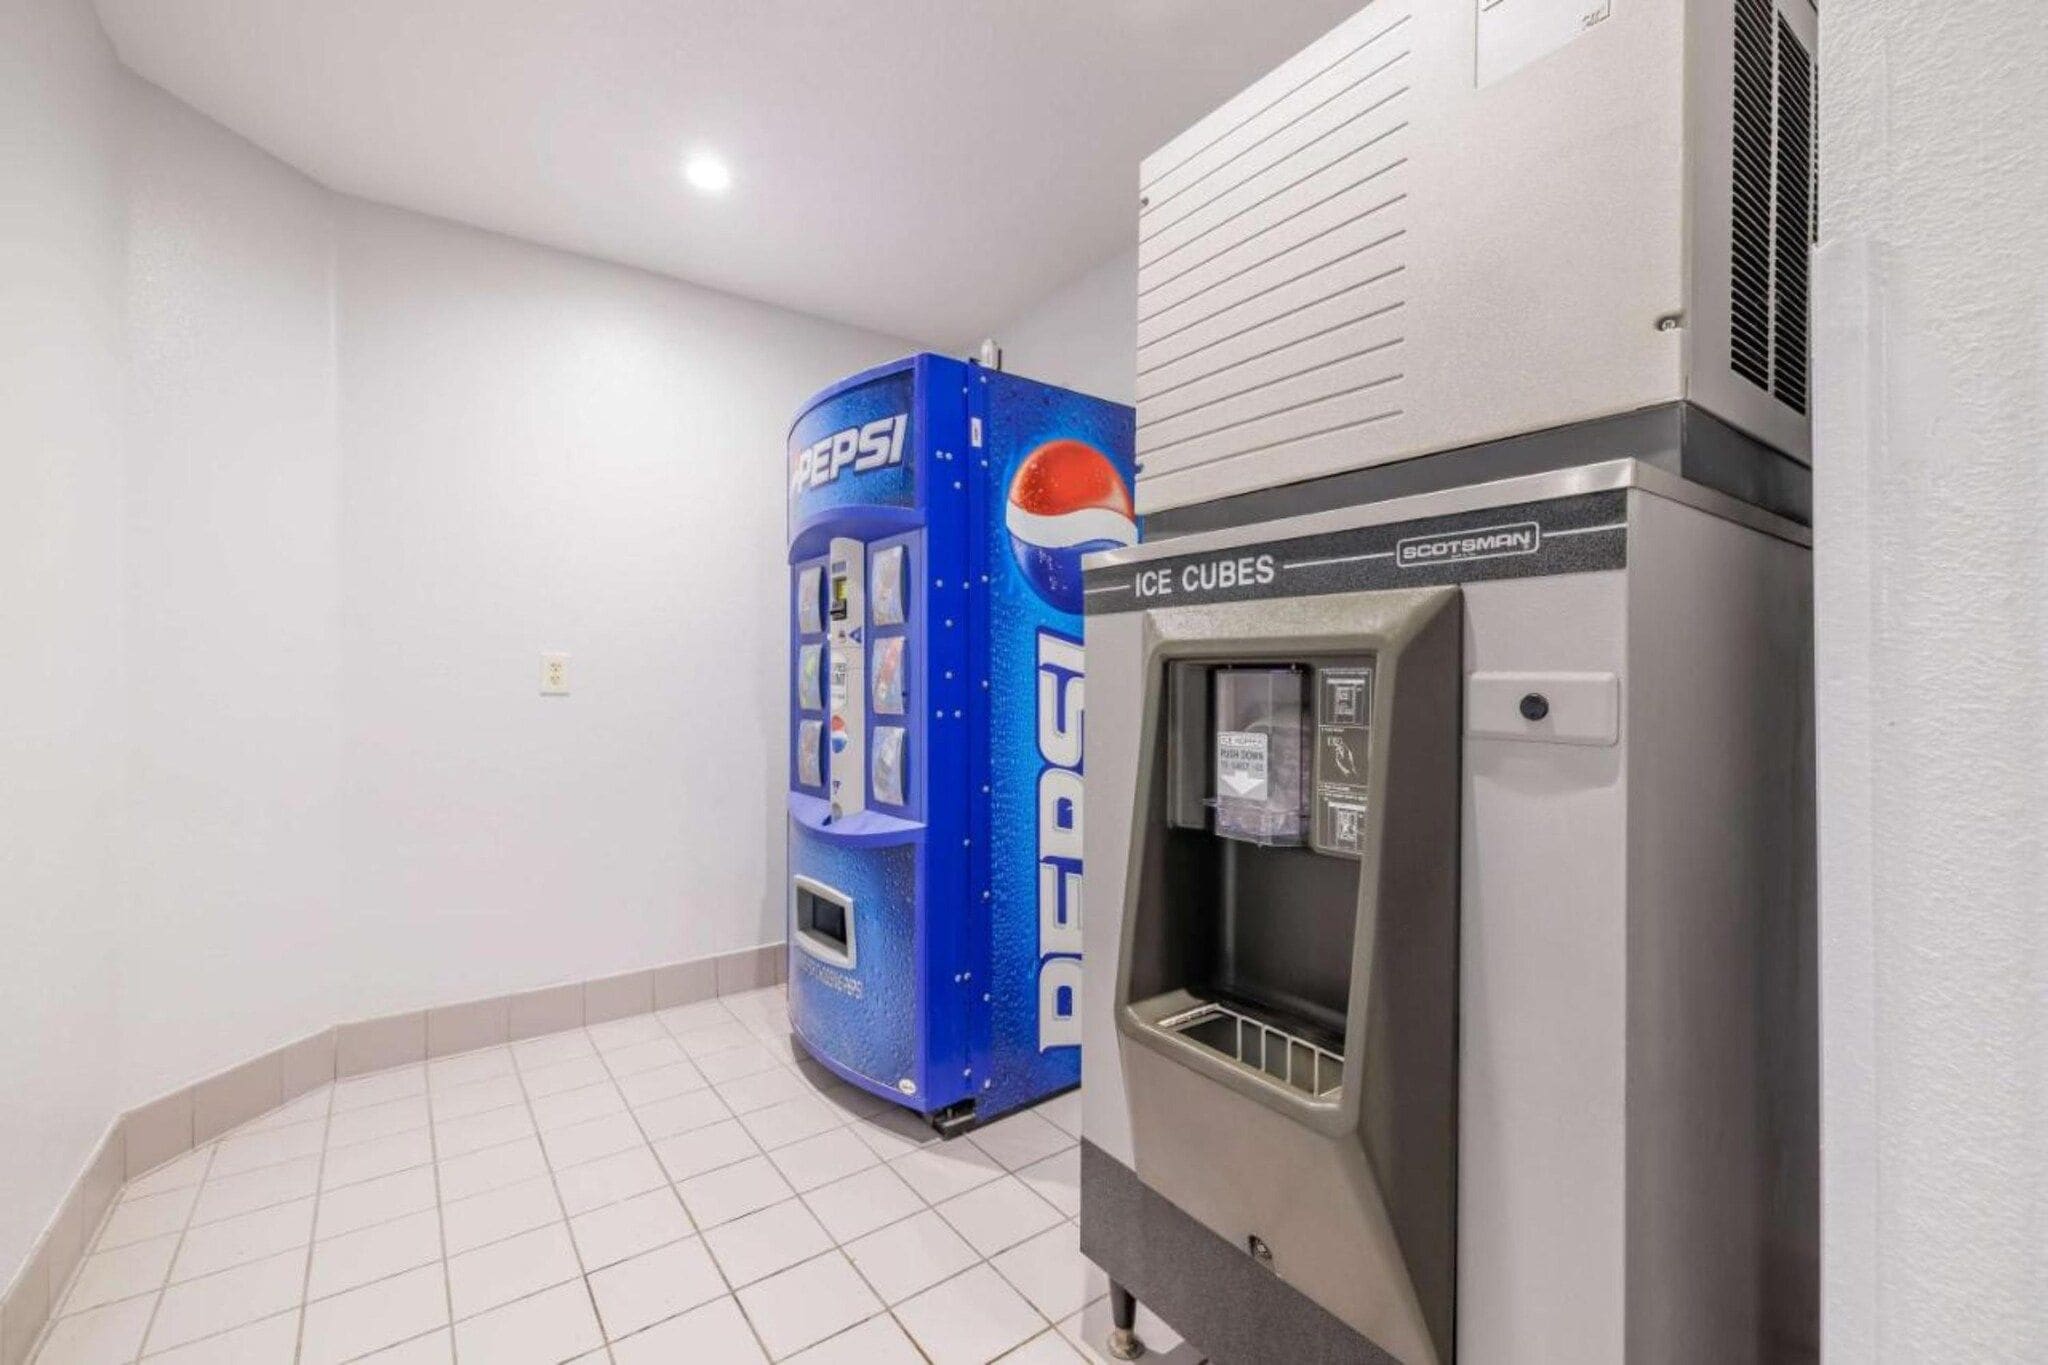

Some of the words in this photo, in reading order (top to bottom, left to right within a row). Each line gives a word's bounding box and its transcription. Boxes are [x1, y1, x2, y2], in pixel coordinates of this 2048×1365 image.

[791, 413, 908, 493] PEPSI
[1402, 530, 1531, 560] SCOTSMAN
[1135, 568, 1172, 597] ICE
[1182, 554, 1275, 592] CUBES
